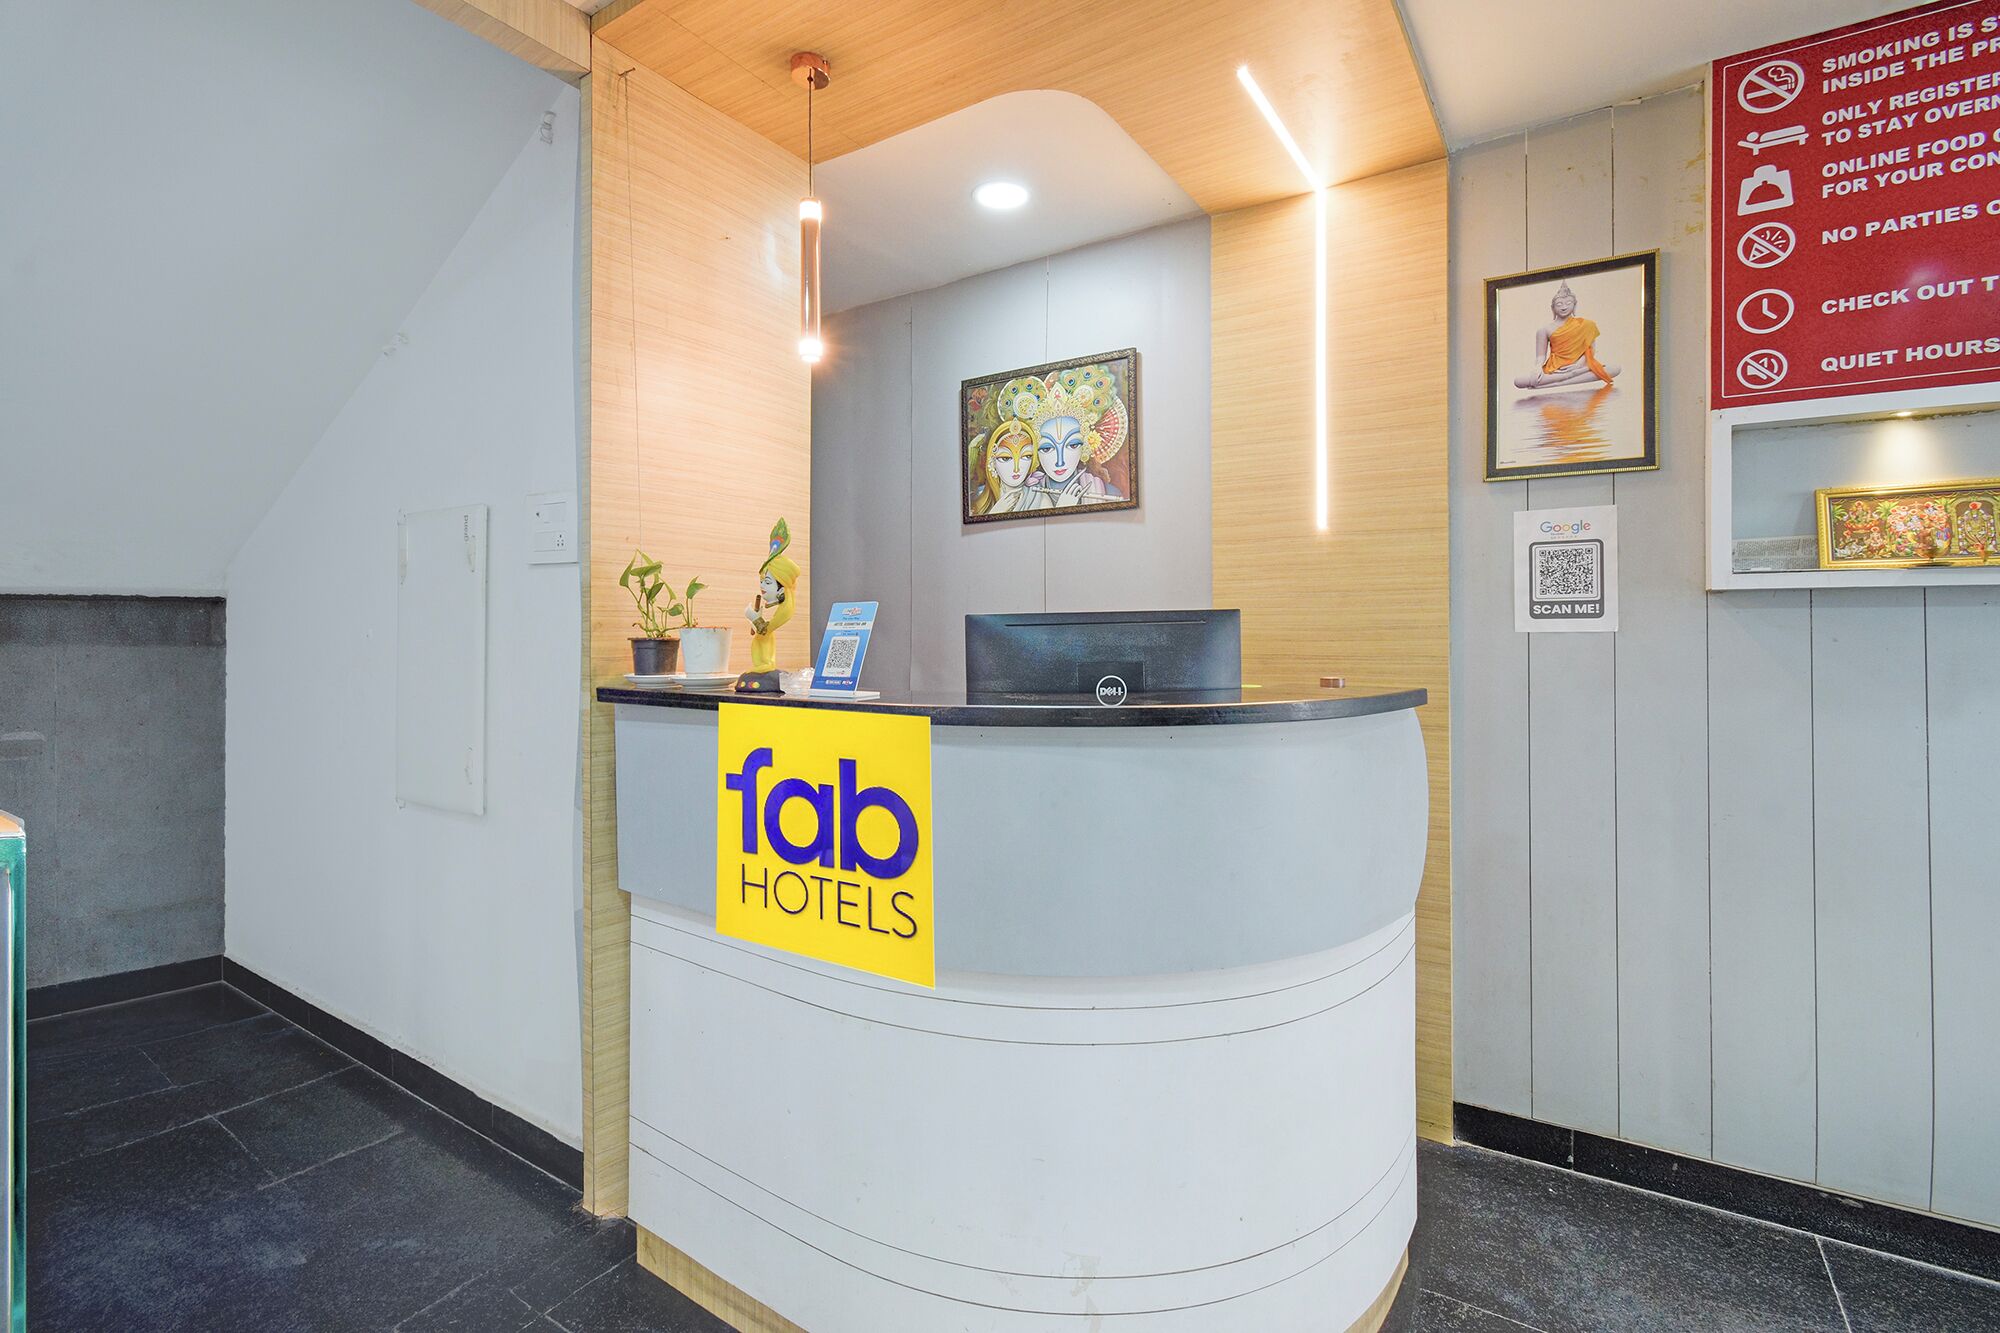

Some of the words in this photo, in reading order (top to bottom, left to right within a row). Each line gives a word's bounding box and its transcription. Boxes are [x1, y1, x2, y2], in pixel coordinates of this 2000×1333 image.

[1822, 31, 1940, 74] SMOKING
[1948, 22, 1974, 42] IS
[1981, 15, 2000, 33] S
[1822, 60, 1905, 94] INSIDE
[1911, 46, 1964, 71] THE
[1821, 98, 1882, 126] ONLY
[1821, 128, 1852, 146] TO
[1857, 111, 1919, 139] STAY
[1821, 146, 1910, 178] ONLINE
[1917, 132, 1985, 159] FOOD
[1821, 177, 1868, 199] FOR
[1874, 162, 1944, 188] YOUR
[1950, 151, 2000, 173] CON
[1821, 226, 1858, 245] NO
[1865, 203, 1979, 237] PARTIES
[1821, 288, 1909, 315] CHECK
[1916, 279, 1974, 301] OUT
[1821, 349, 1898, 372] QUIET
[1905, 337, 2000, 363] HOURS
[1539, 519, 1591, 534] Google
[1533, 604, 1572, 615] SCAN
[1574, 603, 1600, 614] ME!
[1100, 686, 1123, 696] DELL
[725, 747, 919, 879] fab
[742, 863, 918, 939] HOTELS
